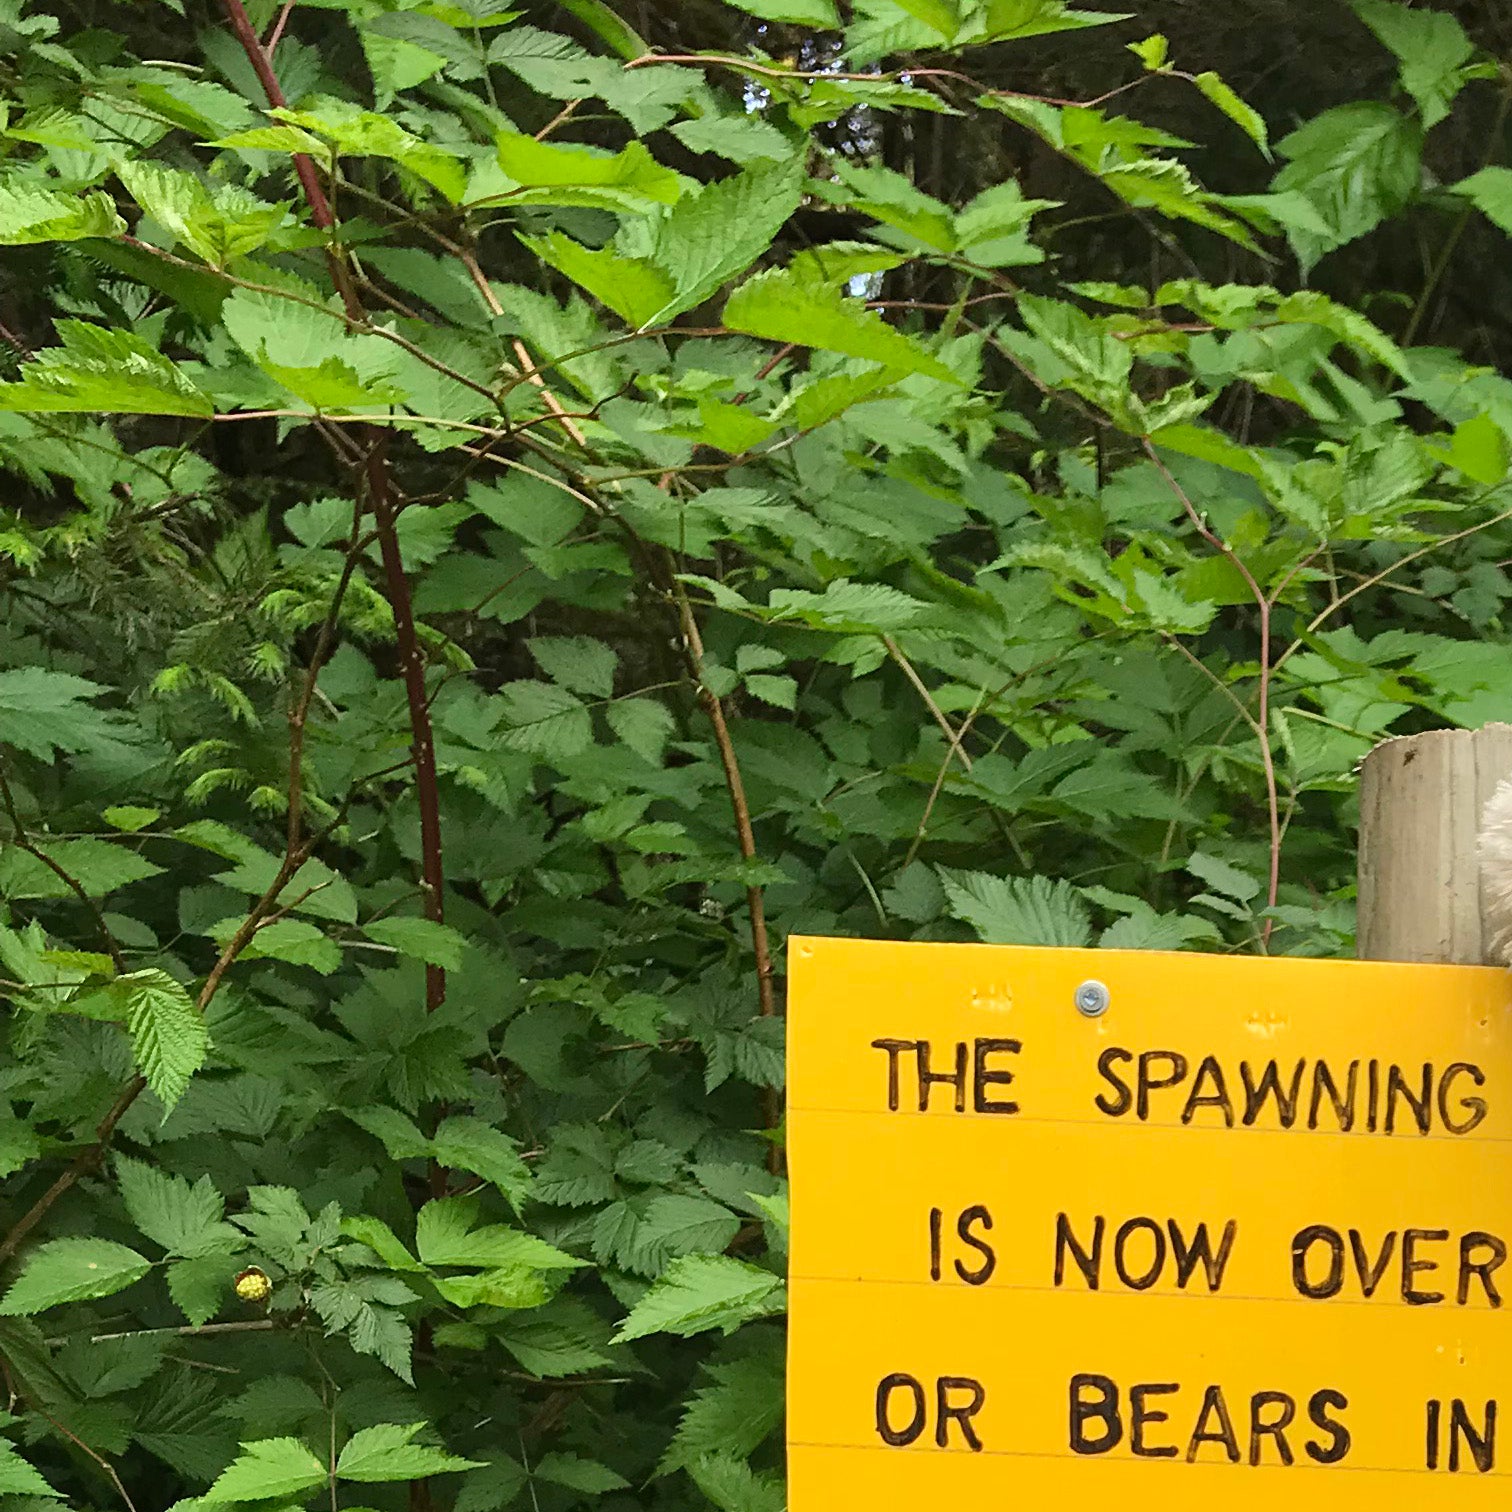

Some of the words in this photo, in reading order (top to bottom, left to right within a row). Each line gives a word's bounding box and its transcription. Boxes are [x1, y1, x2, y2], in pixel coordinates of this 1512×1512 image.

[871, 1038, 1021, 1114] THE
[1095, 1048, 1486, 1136] SPAWNING
[930, 1206, 995, 1285] IS
[1054, 1213, 1234, 1291] NOW
[876, 1373, 984, 1452] OR
[1070, 1374, 1350, 1466] BEARS
[1427, 1399, 1496, 1473] IN
